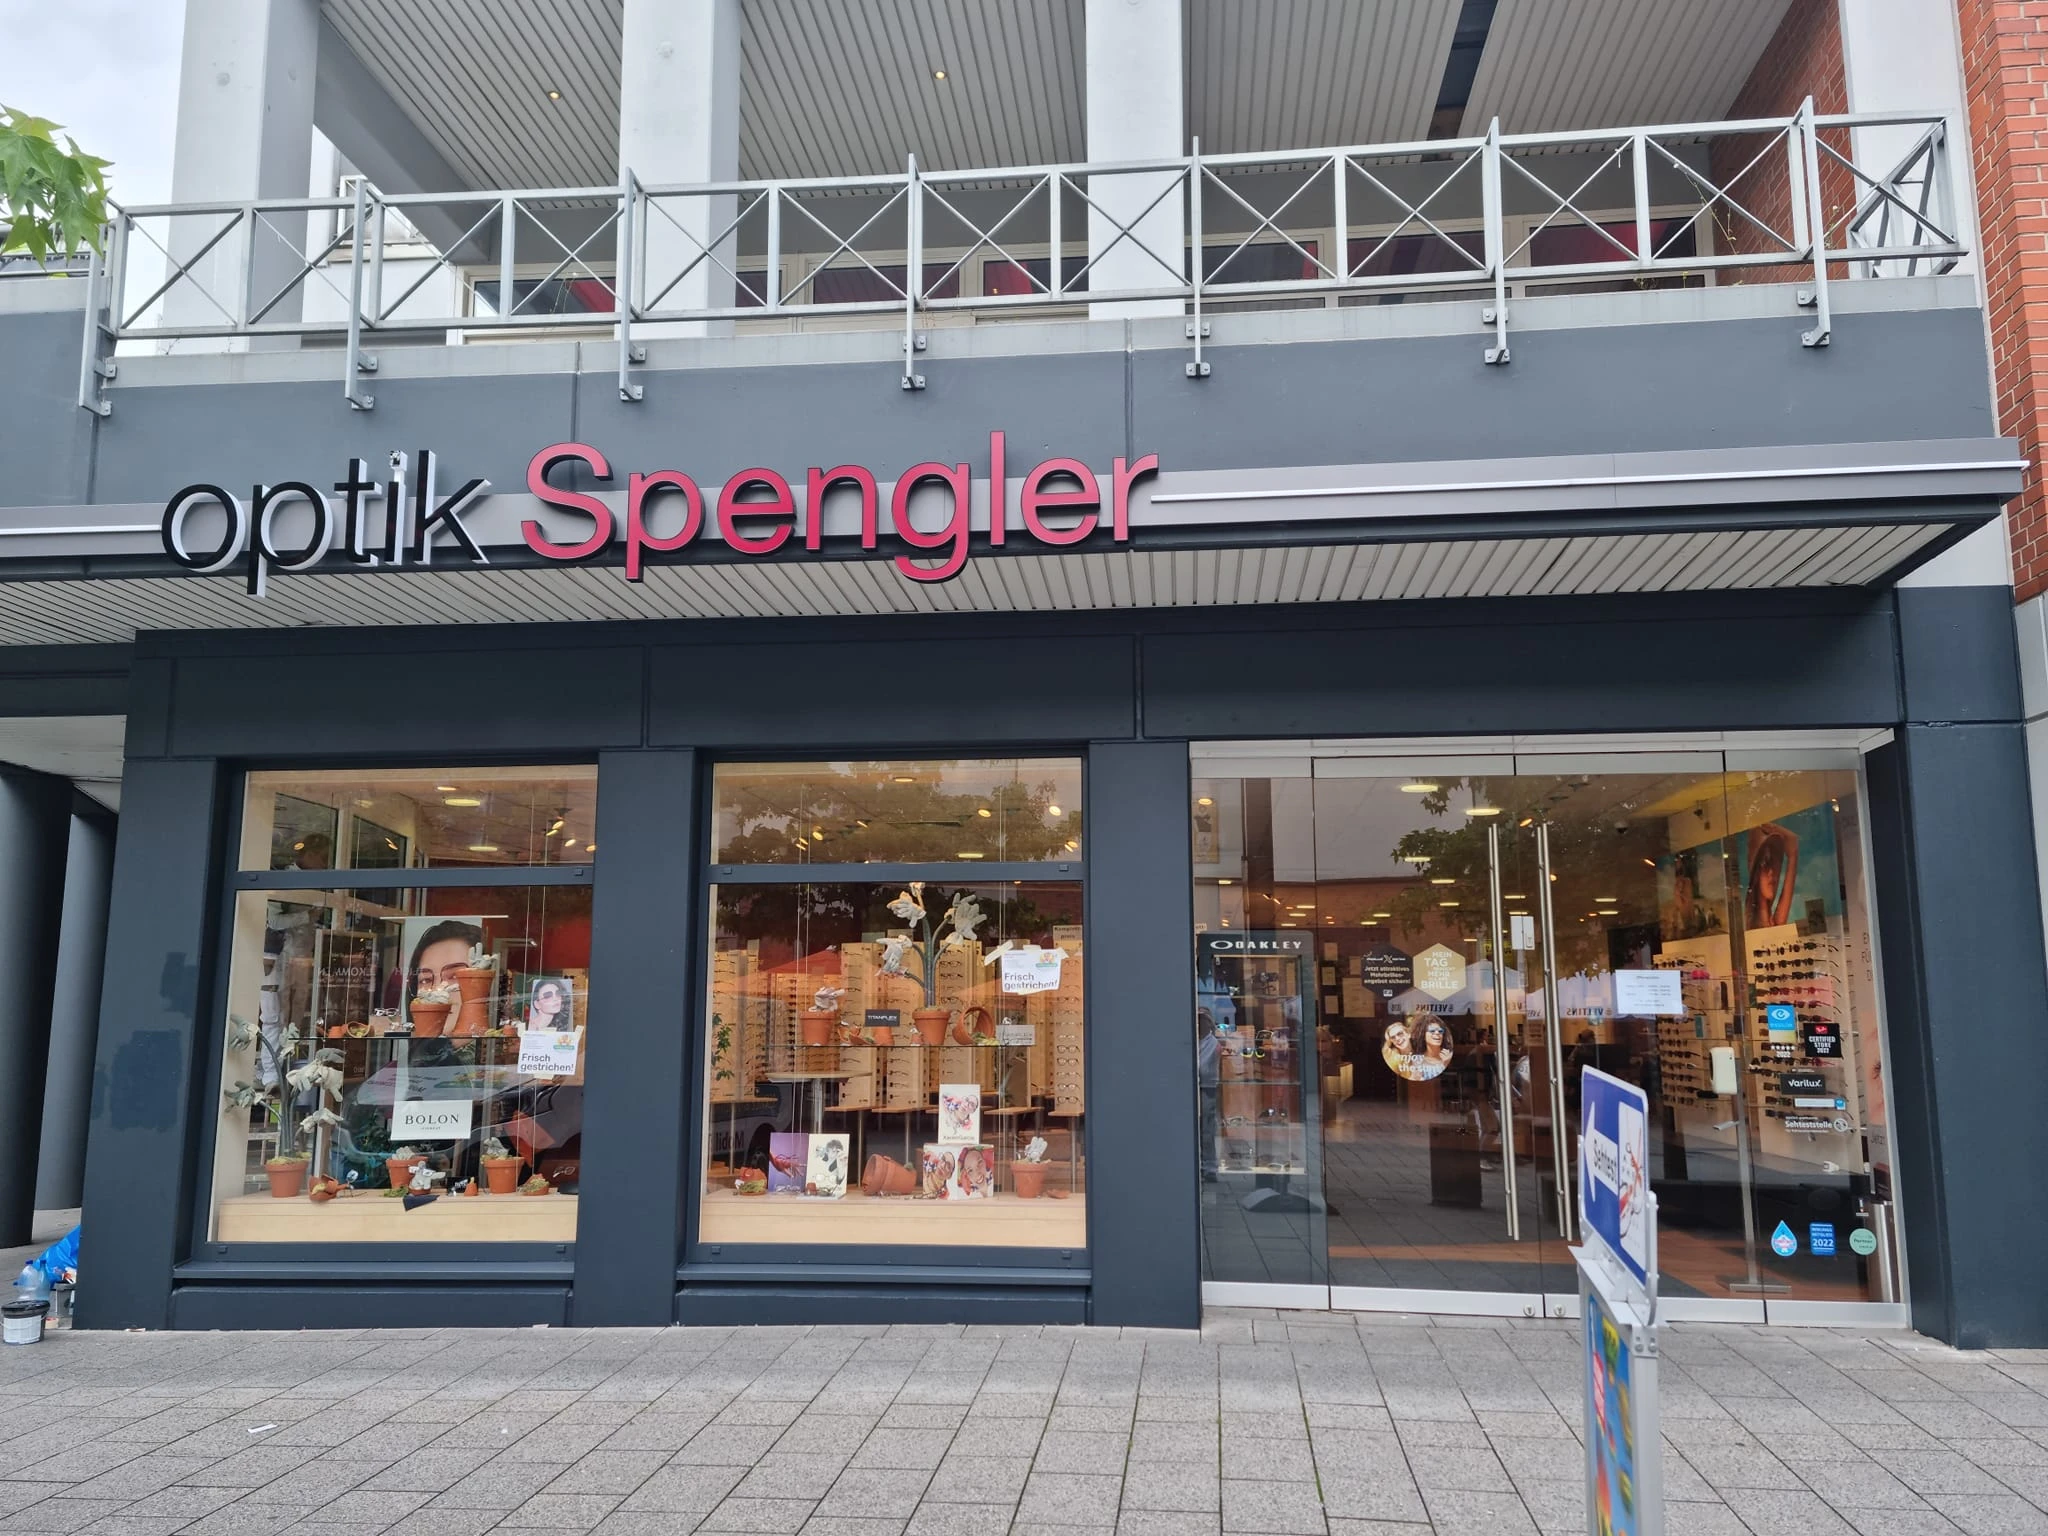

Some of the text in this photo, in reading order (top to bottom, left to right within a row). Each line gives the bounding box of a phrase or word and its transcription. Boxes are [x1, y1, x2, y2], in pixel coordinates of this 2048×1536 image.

[161, 430, 1160, 599] optik Spengler
[1236, 940, 1302, 950] OAKLEY
[1423, 957, 1448, 968] TAG
[1004, 972, 1035, 981] Frisch
[1004, 980, 1058, 991] gestrichen!
[1421, 980, 1459, 990] BRILLE
[1808, 1035, 1836, 1043] CERTIFIED
[521, 1053, 551, 1062] Frisch
[520, 1063, 574, 1073] gestrichen!
[405, 1114, 459, 1124] BOLON
[1593, 1137, 1618, 1185] Sehtest
